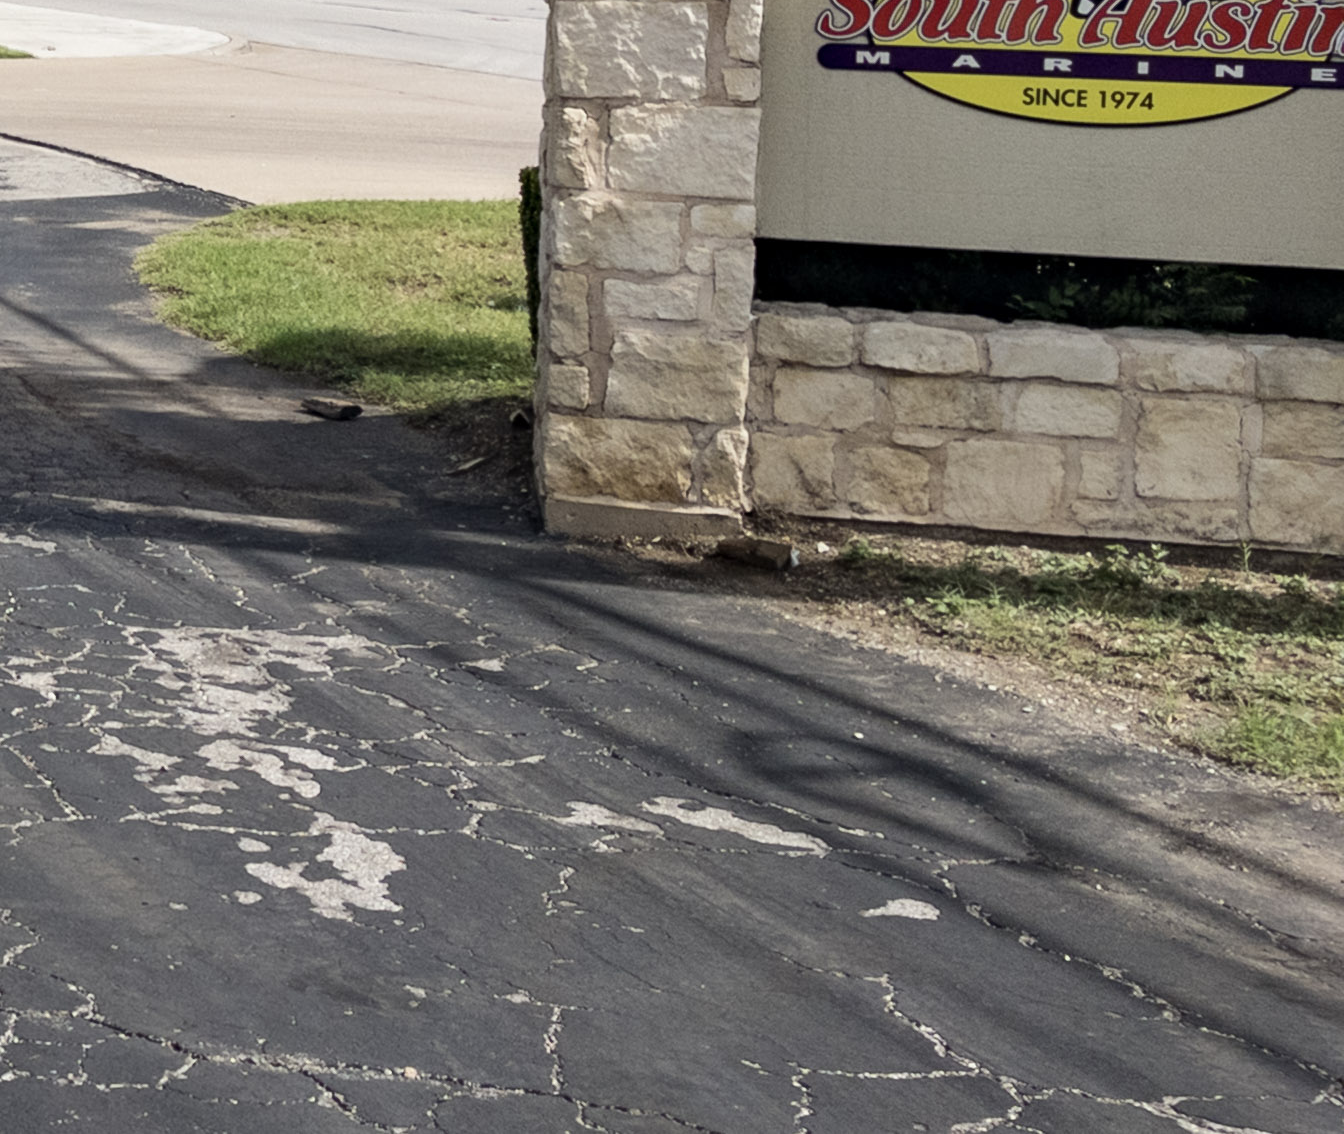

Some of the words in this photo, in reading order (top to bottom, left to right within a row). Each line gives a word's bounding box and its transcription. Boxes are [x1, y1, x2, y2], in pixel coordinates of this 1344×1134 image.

[855, 50, 1338, 82] MARINE
[1022, 87, 1088, 109] SINCE
[1097, 90, 1155, 111] 1974
